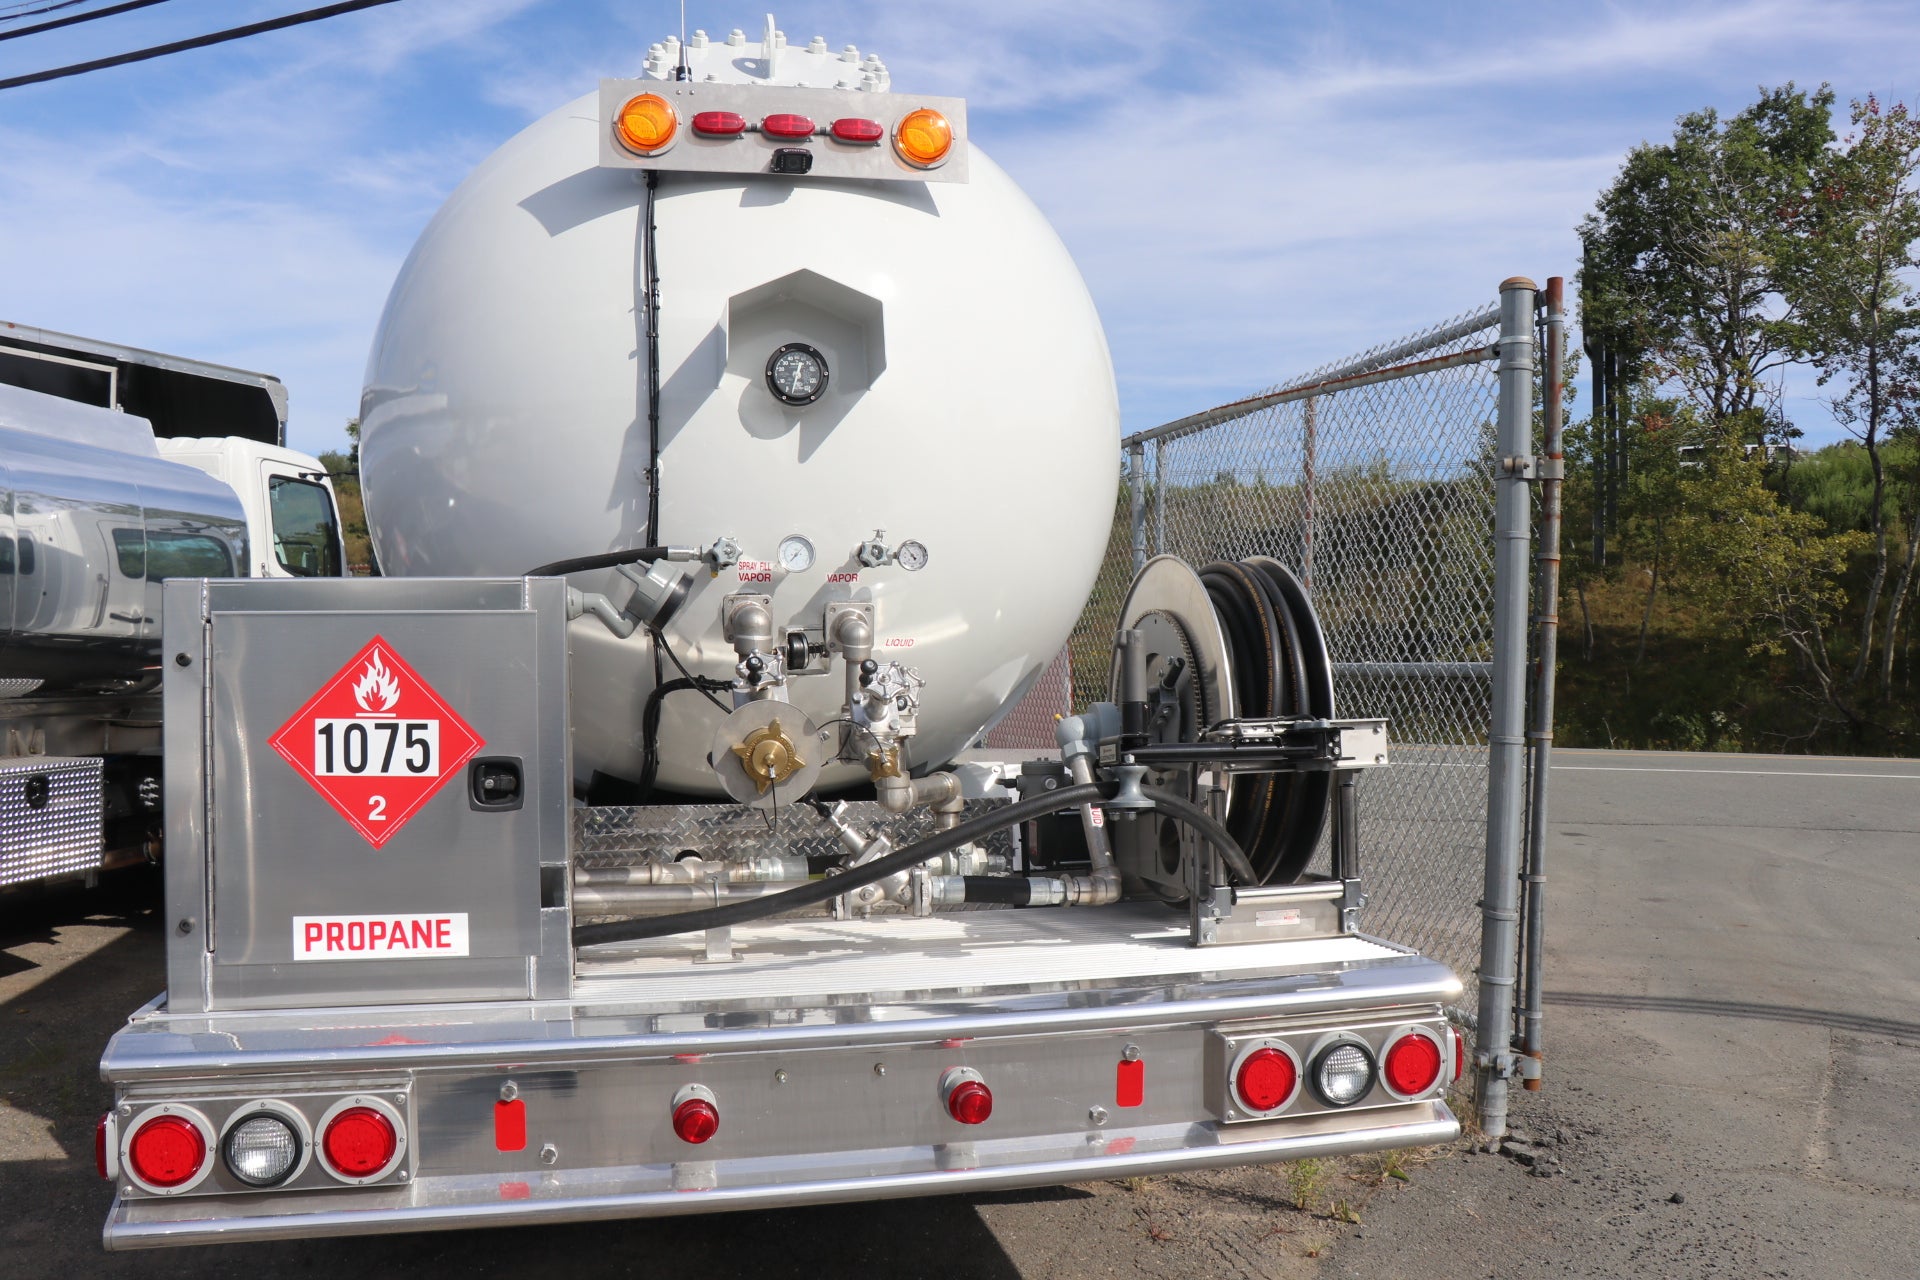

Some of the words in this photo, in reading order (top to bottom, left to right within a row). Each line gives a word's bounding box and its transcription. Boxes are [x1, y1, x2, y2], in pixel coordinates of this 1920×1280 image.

[738, 561, 757, 571] SPRAY
[760, 561, 772, 571] FILL
[738, 572, 772, 582] VAPOR
[827, 573, 858, 583] VAPOR
[885, 638, 915, 647] LIQUID
[317, 722, 431, 774] 1075
[368, 795, 387, 821] 2
[1091, 806, 1102, 825] UID
[304, 918, 452, 952] PROPANE
